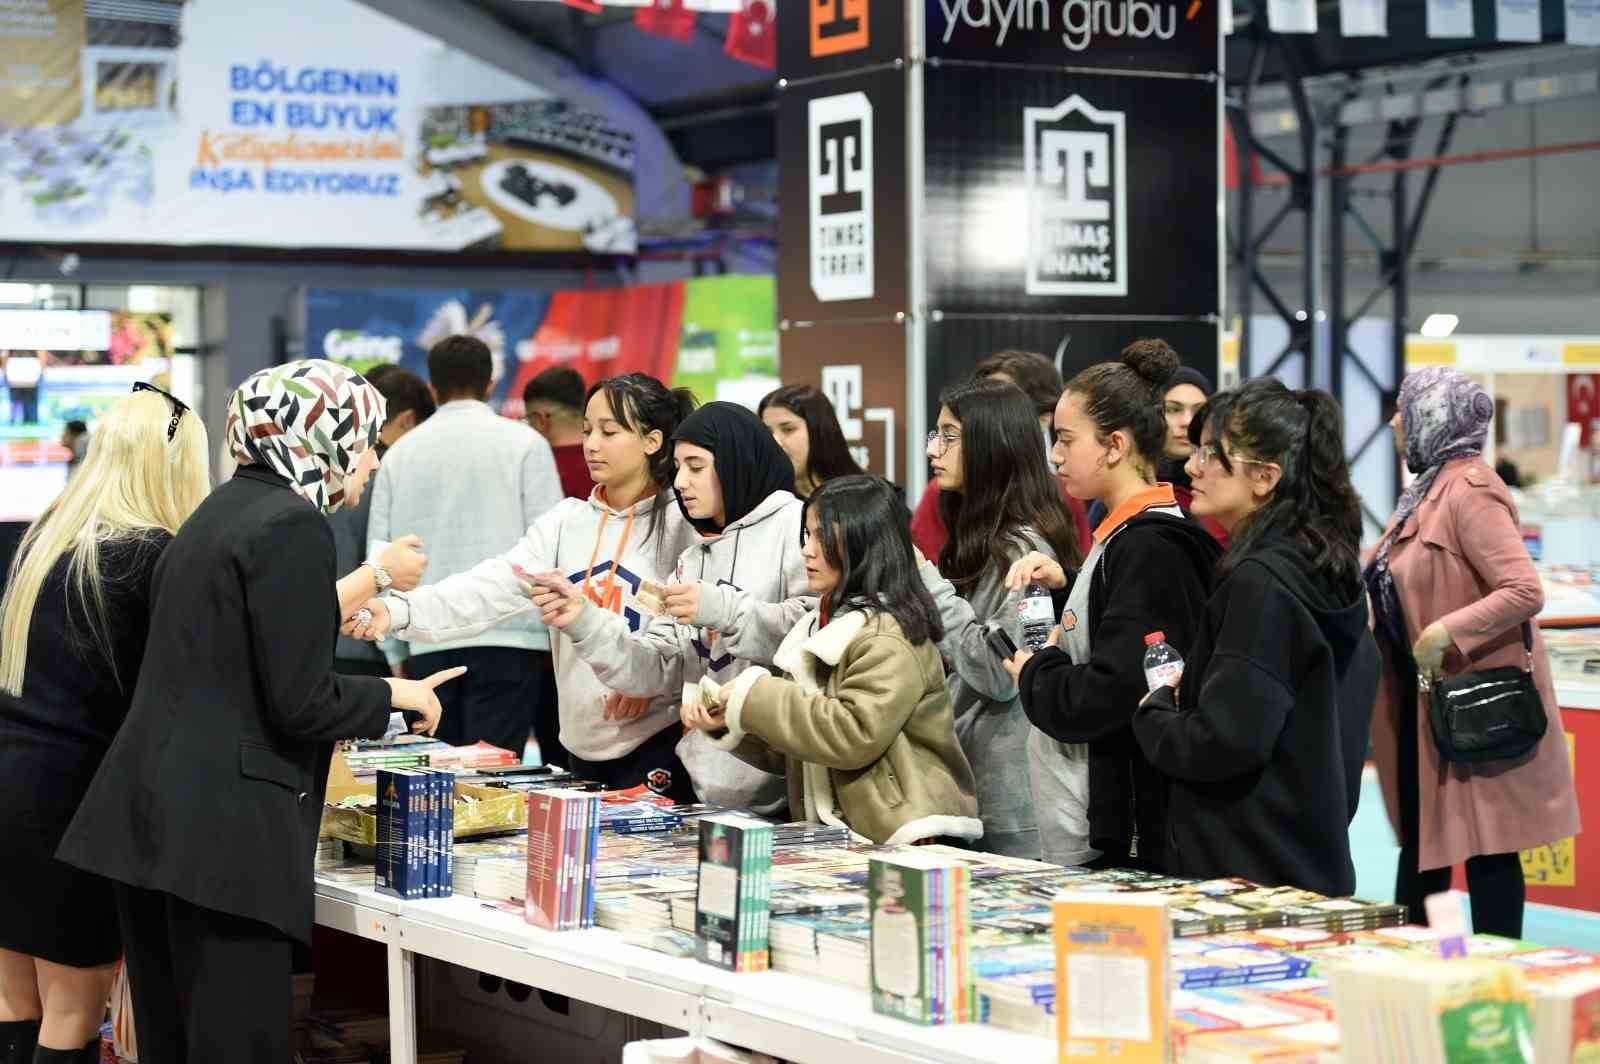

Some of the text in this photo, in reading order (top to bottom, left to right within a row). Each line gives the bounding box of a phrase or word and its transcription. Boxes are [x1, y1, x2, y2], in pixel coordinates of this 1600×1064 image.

[1061, 0, 1177, 51] grubu
[232, 100, 275, 126] EN
[1044, 223, 1111, 253] MAŞ
